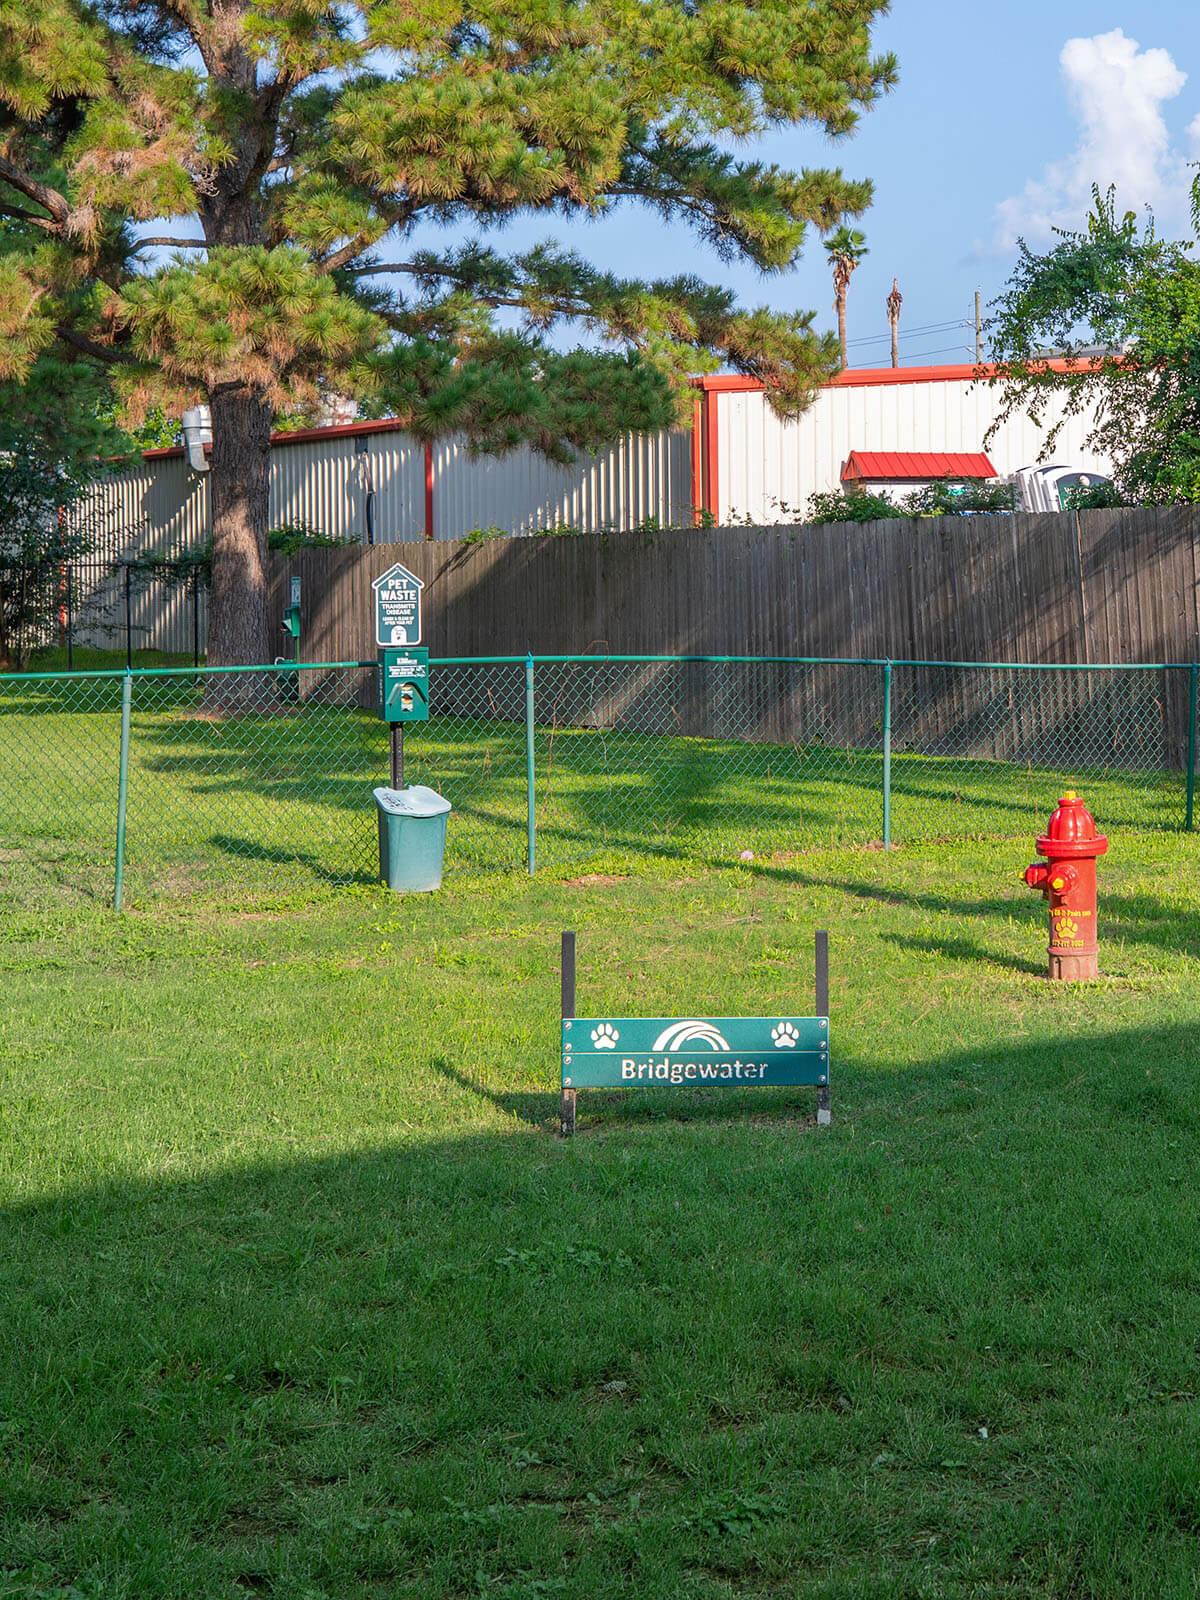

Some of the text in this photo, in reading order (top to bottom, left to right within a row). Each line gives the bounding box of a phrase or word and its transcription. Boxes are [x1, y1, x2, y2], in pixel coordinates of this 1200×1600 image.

[388, 579, 408, 590] PET
[380, 590, 417, 601] WASTE
[622, 1057, 768, 1084] Bridgewater
